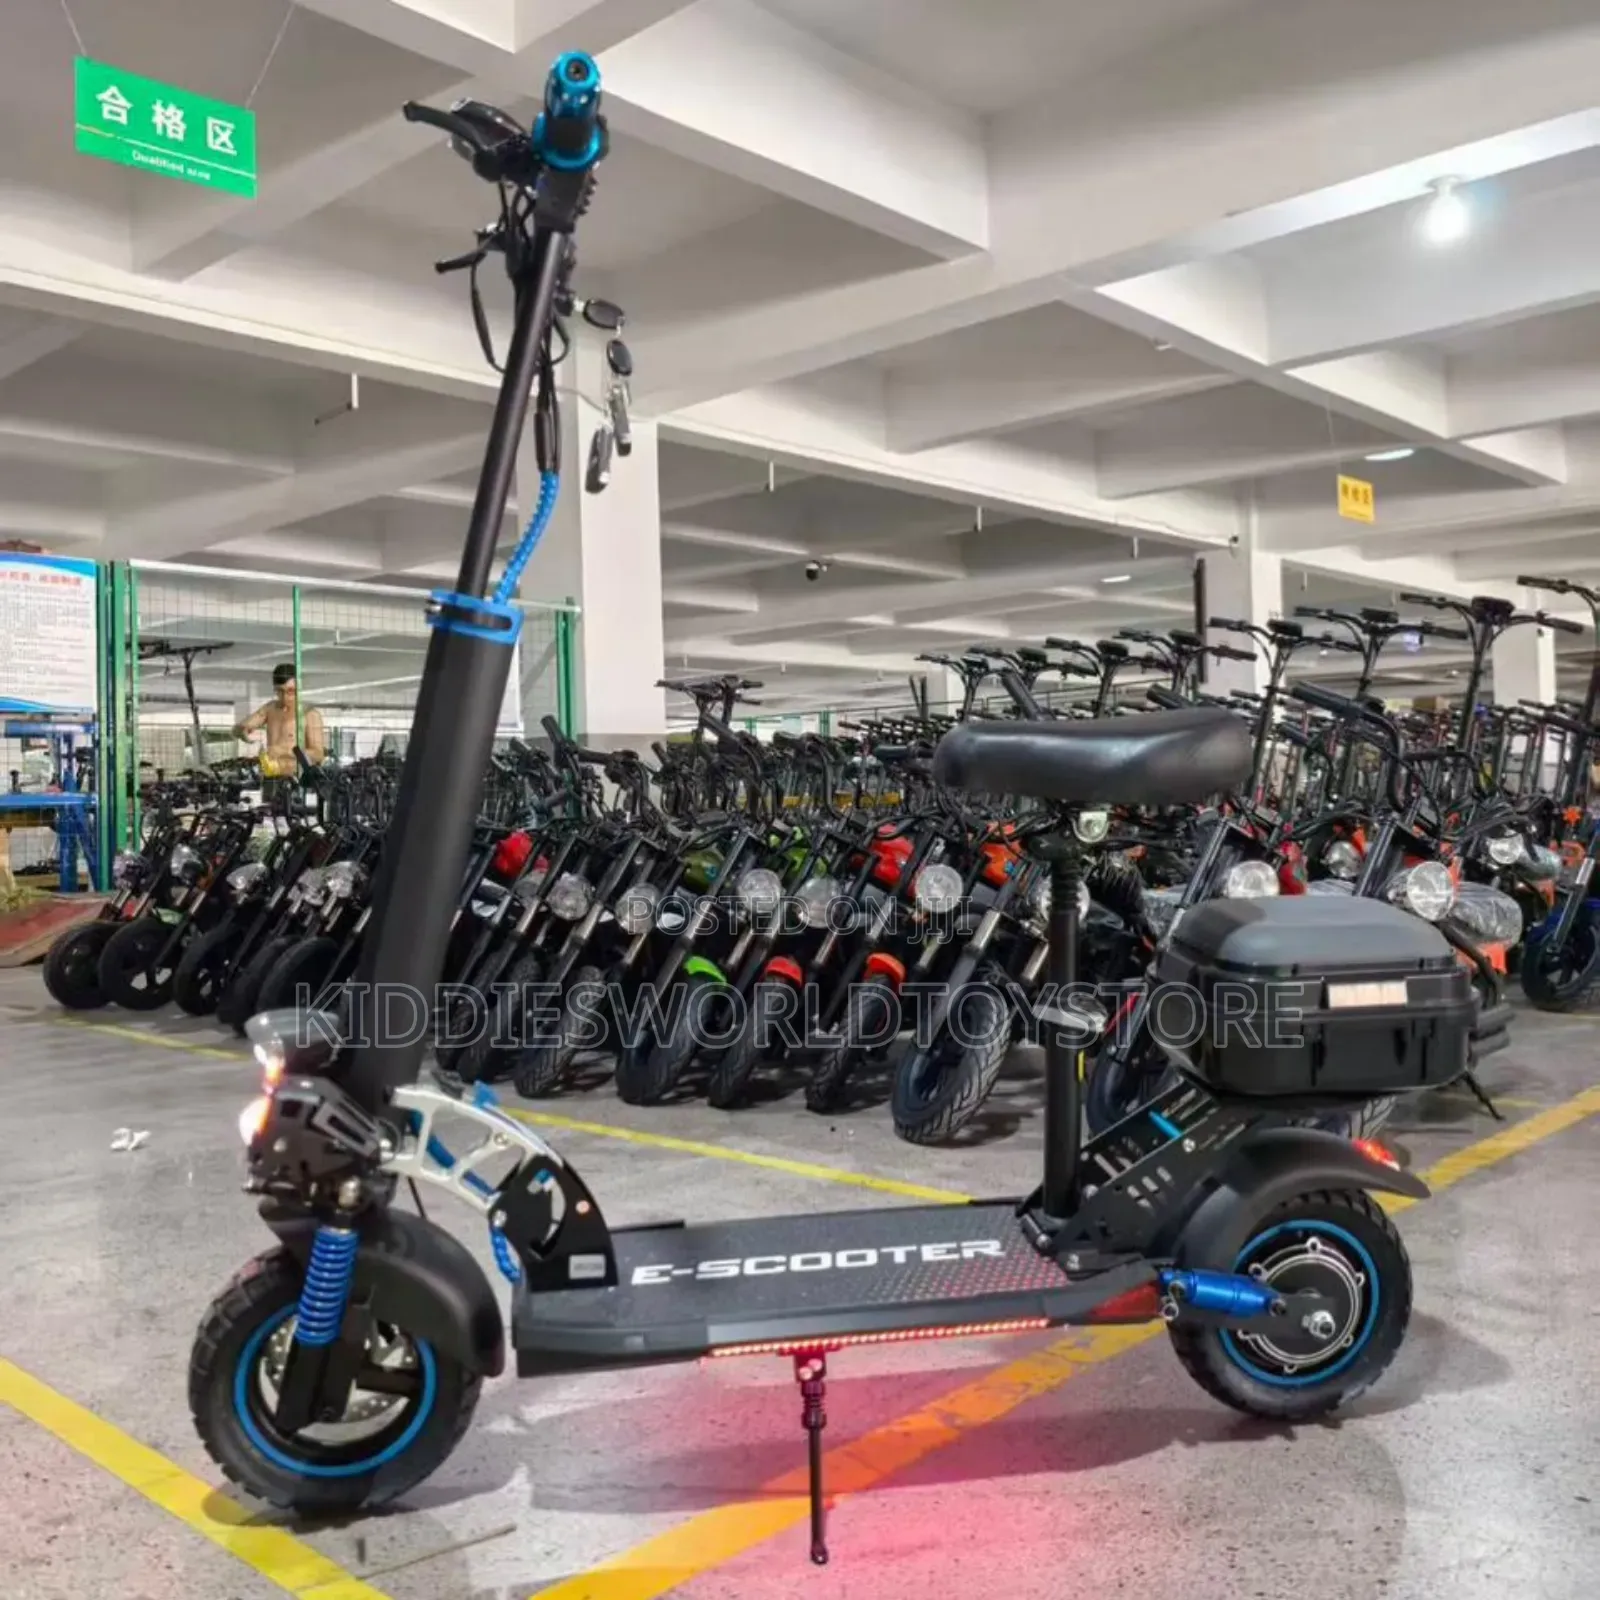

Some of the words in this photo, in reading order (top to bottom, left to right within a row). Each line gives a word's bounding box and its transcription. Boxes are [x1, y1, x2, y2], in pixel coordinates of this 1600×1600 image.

[96, 85, 238, 155] 合格区
[631, 1239, 1006, 1286] E-SCOOTER
